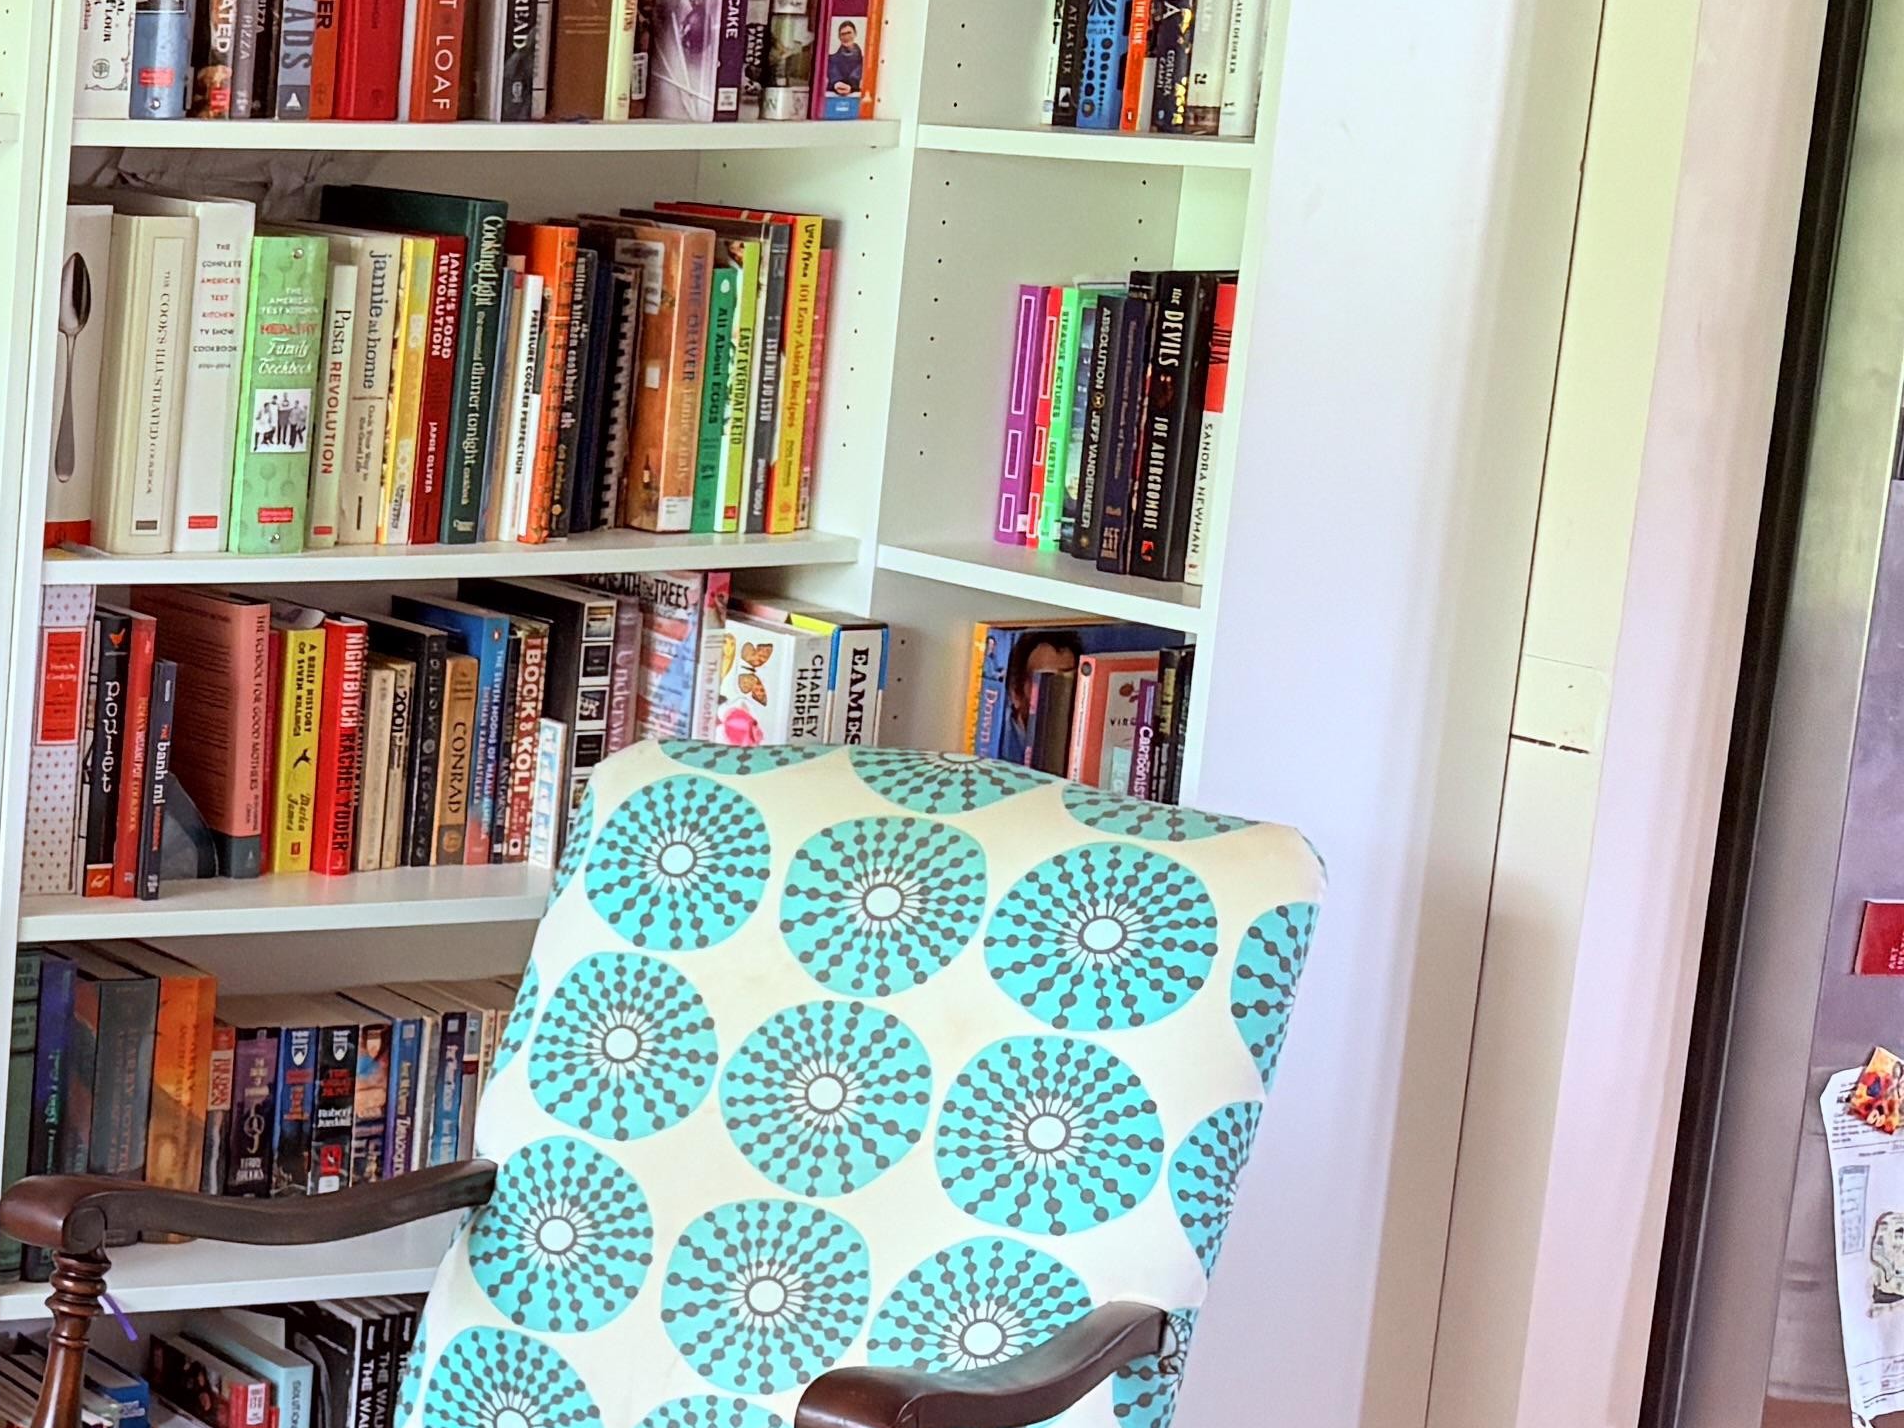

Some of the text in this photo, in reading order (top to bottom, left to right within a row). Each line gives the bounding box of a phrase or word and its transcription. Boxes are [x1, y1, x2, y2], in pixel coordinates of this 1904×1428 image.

[431, 35, 454, 110] LOAF
[368, 251, 392, 319] jamie
[1095, 307, 1112, 390] ABSOLUTION
[1158, 309, 1185, 367] DEVILS
[319, 310, 351, 475] Pasta REVOLUTION
[1191, 423, 1213, 554] SANDRA NEWMAN
[102, 681, 121, 793] poulet
[338, 632, 363, 792] NIGHTBITCH RACHEL
[844, 647, 869, 745] EAMES
[446, 721, 468, 814] CONRAD
[514, 735, 533, 793] KOLI
